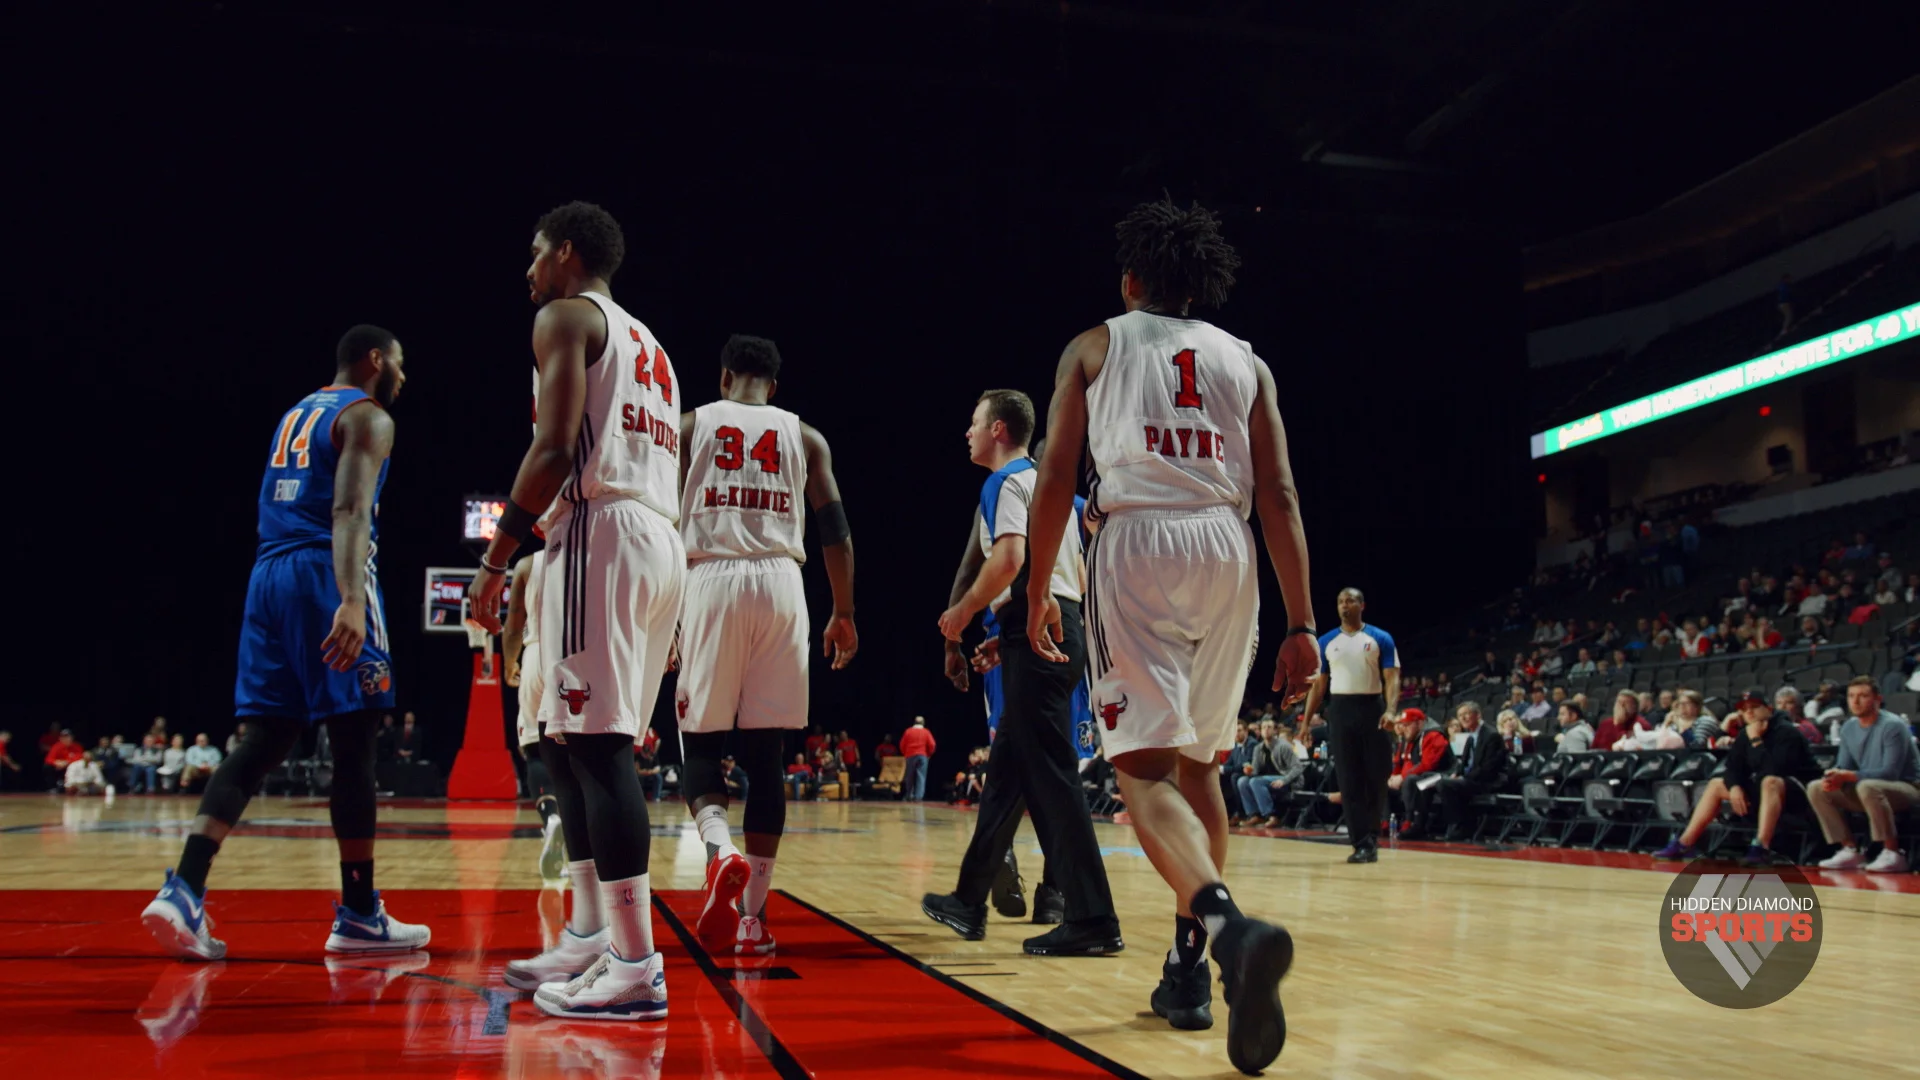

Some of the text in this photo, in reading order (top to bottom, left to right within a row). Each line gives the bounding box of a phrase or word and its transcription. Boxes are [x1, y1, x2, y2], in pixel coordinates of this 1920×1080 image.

[629, 325, 672, 406] 24
[1172, 348, 1203, 411] 1
[1745, 339, 1830, 385] FAVORITE
[1831, 323, 1875, 357] FOR
[1875, 314, 1901, 341] 40
[270, 407, 320, 468] 14
[715, 425, 780, 474] 34
[1144, 425, 1224, 463] PAYNE
[704, 485, 790, 513] McKINNIE
